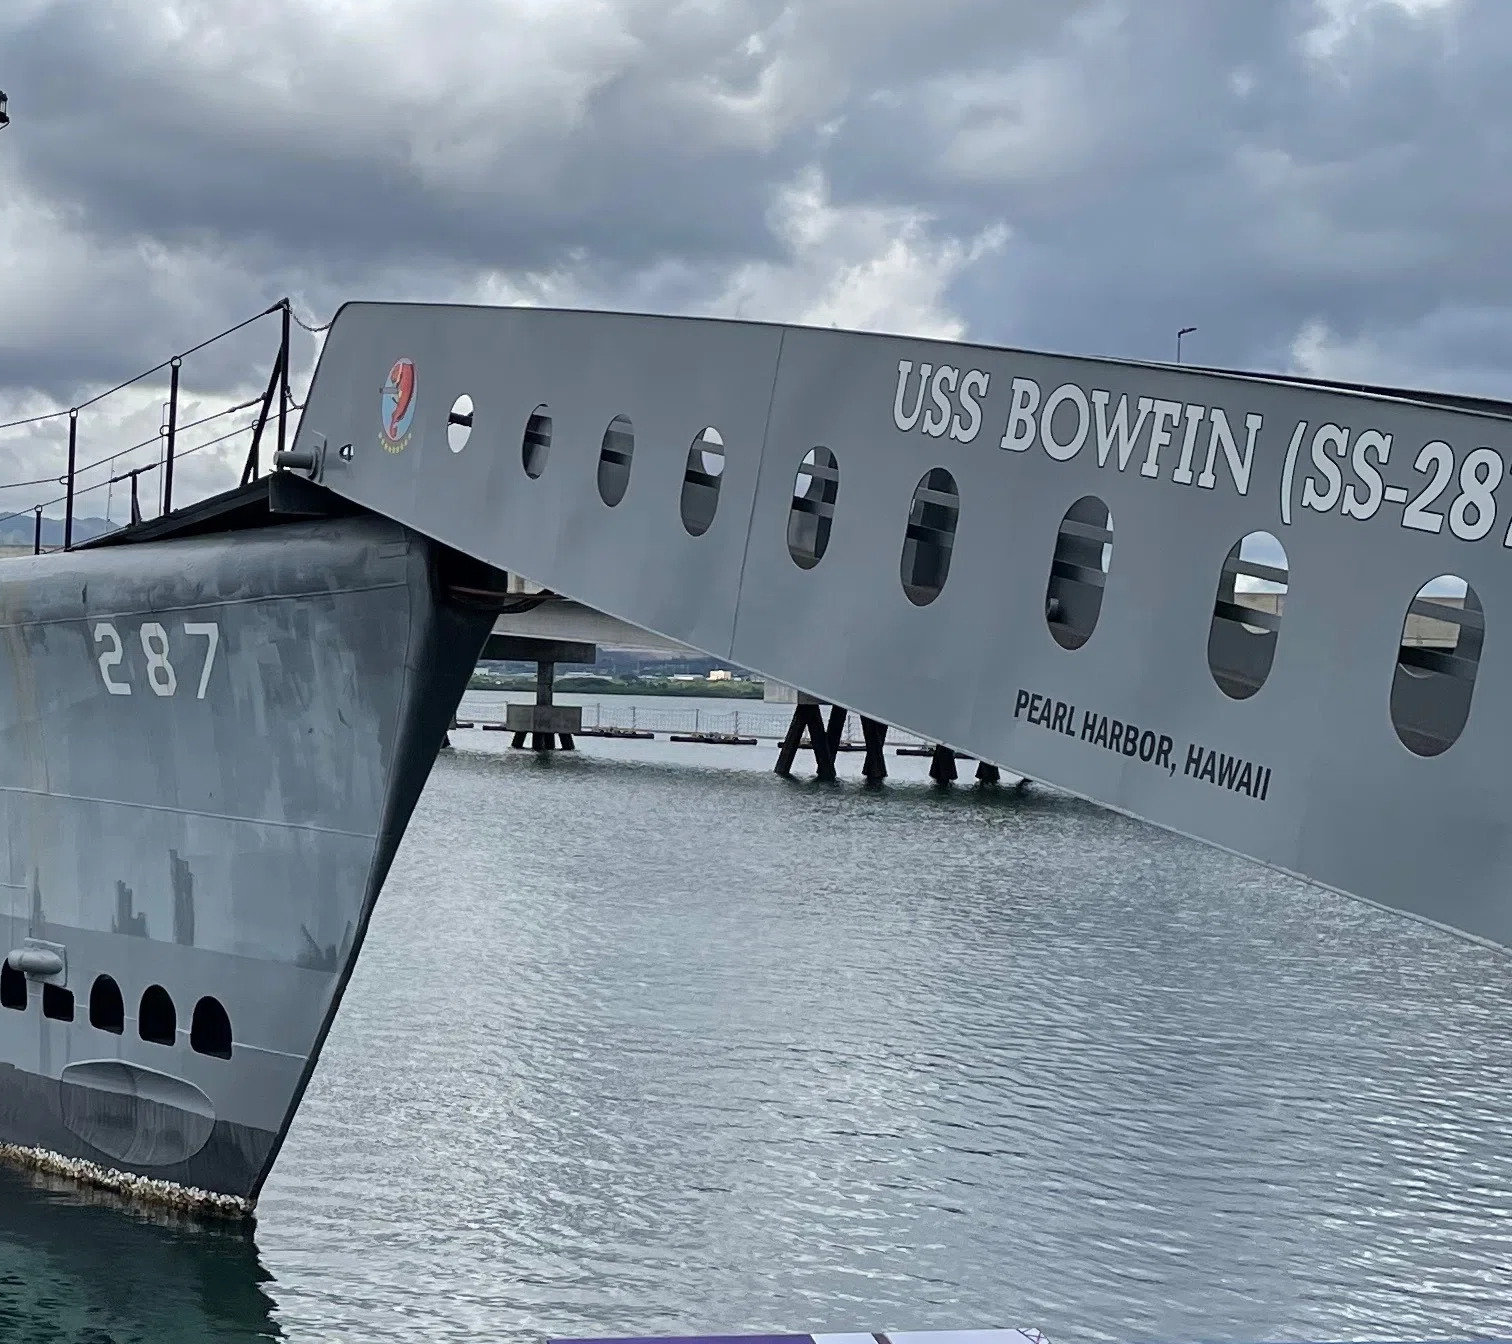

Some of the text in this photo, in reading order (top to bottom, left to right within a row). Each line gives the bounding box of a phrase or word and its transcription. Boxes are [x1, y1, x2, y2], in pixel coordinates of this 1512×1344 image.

[893, 359, 1512, 548] USS BOWFIN (SS-28
[94, 622, 219, 699] 287
[1013, 689, 1272, 801] PEARL HARBOR, HAWAII
